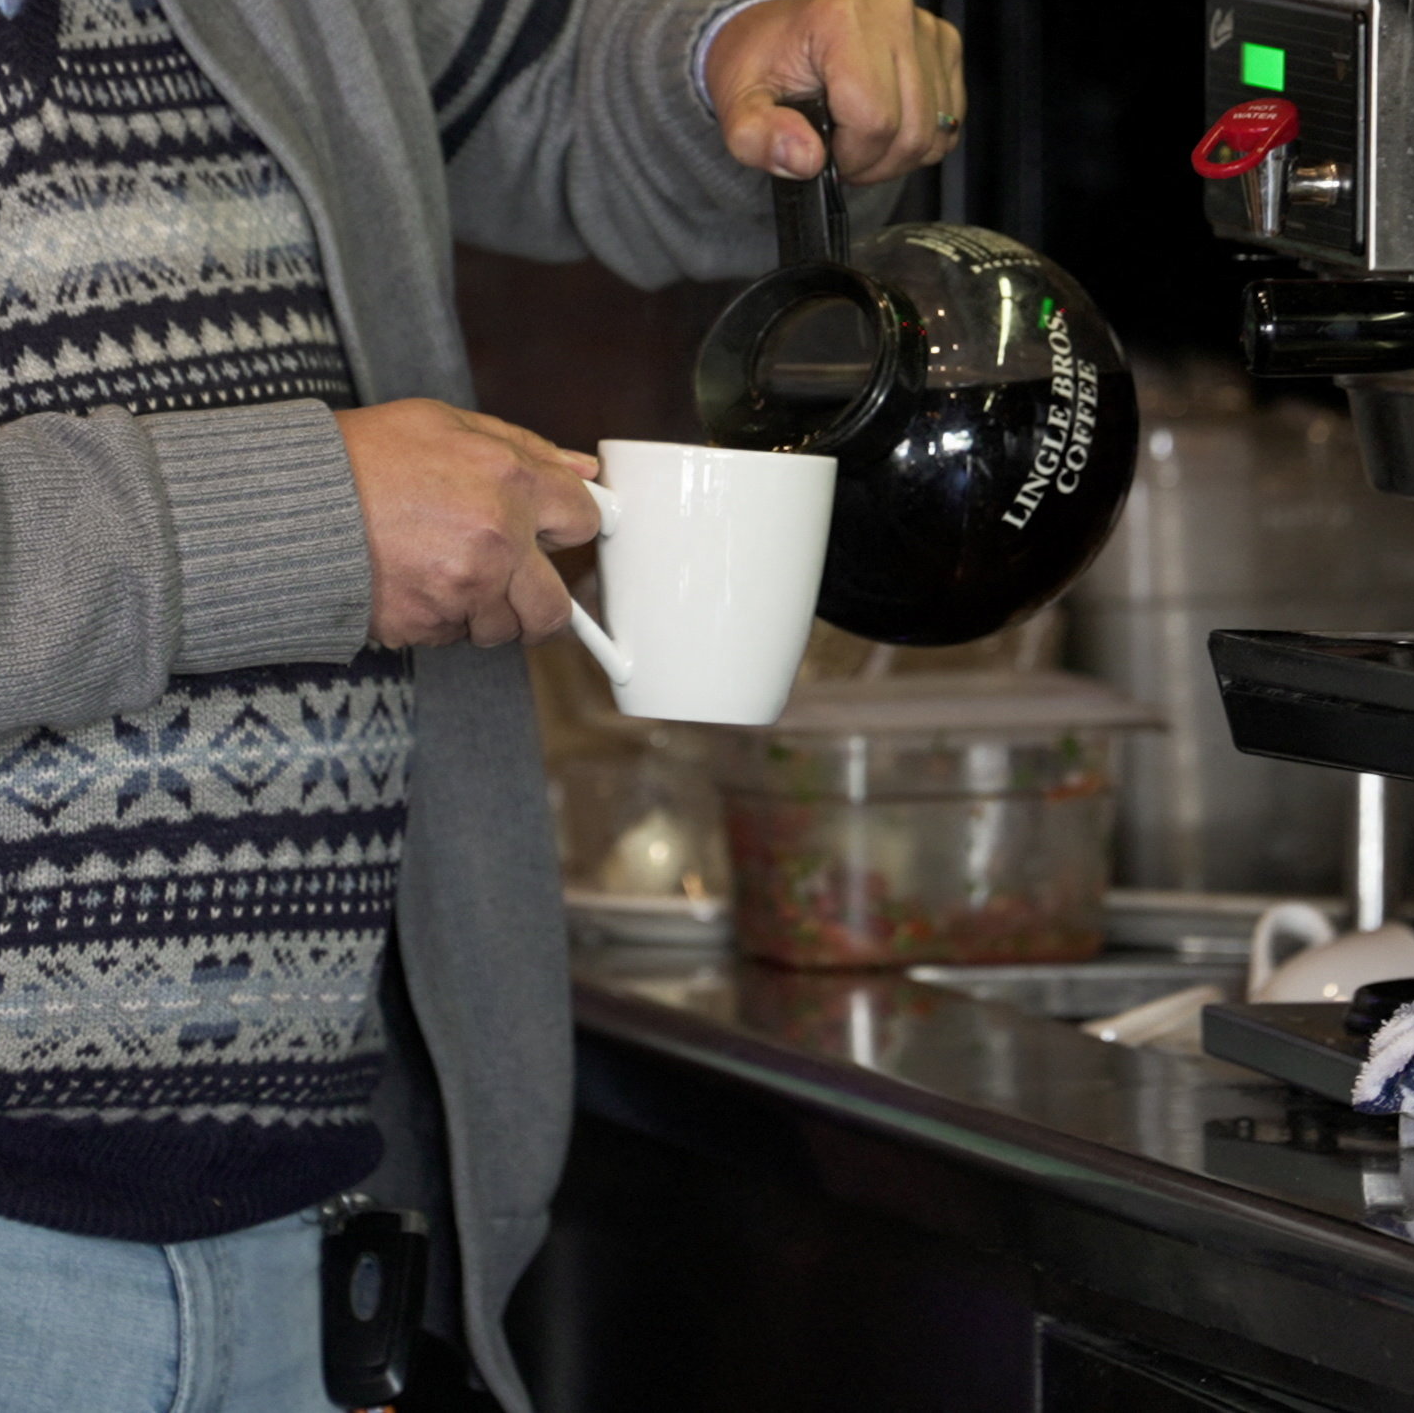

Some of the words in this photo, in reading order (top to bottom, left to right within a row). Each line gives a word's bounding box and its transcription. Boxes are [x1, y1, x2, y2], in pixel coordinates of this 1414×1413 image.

[1232, 112, 1278, 120] WATER
[1248, 104, 1277, 112] HOT
[1001, 404, 1072, 530] LINGLE
[1046, 310, 1074, 400] BROS.
[1056, 359, 1099, 495] COFFEE
